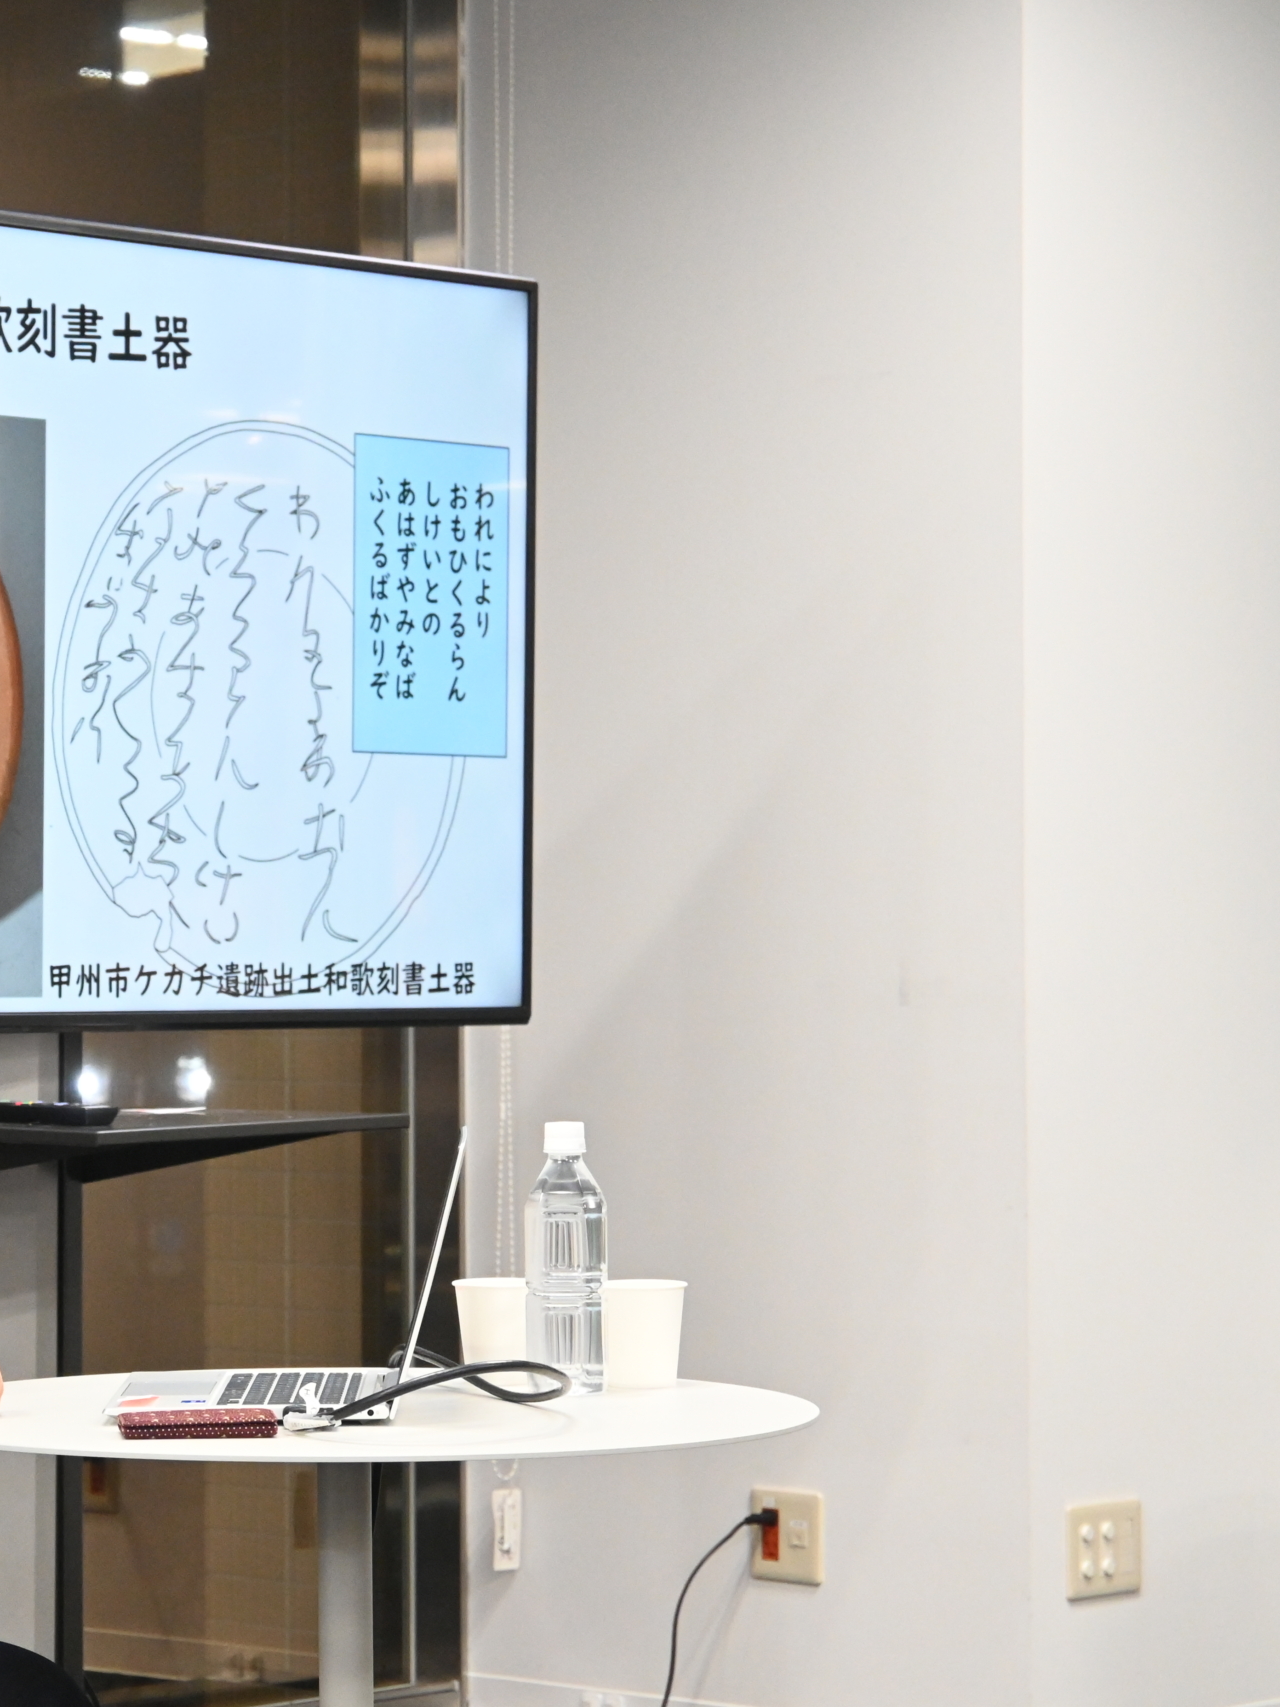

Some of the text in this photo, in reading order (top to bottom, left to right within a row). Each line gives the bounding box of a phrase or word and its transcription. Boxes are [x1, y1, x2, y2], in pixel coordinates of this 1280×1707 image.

[370, 477, 390, 700] ふくるばかりぞ
[396, 478, 416, 699] あはずやみなば
[422, 481, 441, 635] しけいとの
[448, 483, 467, 702] おもひくるらん
[474, 483, 494, 637] われにより
[49, 961, 476, 998] 甲州市ケカチ遺跡出土和歌刻書土器
